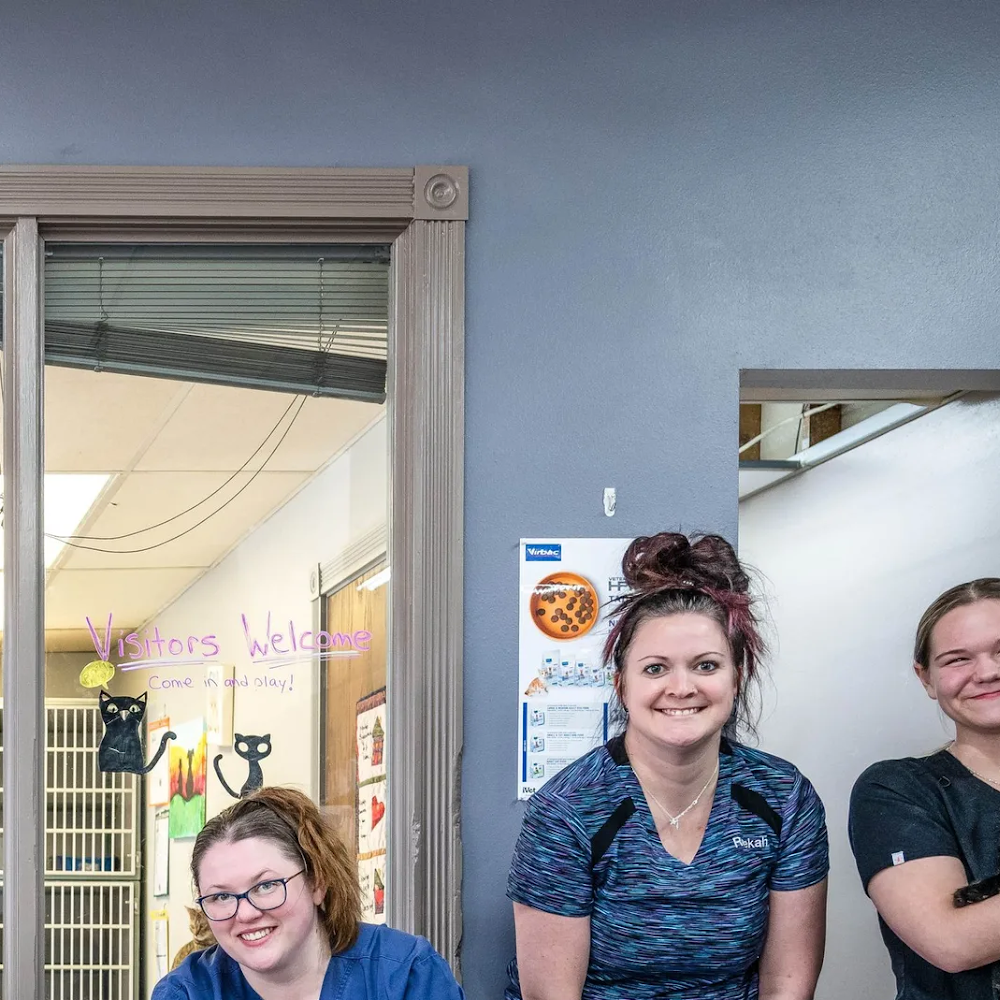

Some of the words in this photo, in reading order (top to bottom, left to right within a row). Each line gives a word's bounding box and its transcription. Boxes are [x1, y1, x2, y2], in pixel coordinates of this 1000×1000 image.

[527, 547, 560, 556] Virbac
[86, 612, 219, 661] Visitors
[240, 611, 372, 657] Welcome
[148, 675, 194, 690] Come
[203, 675, 219, 687] in
[224, 675, 249, 687] and
